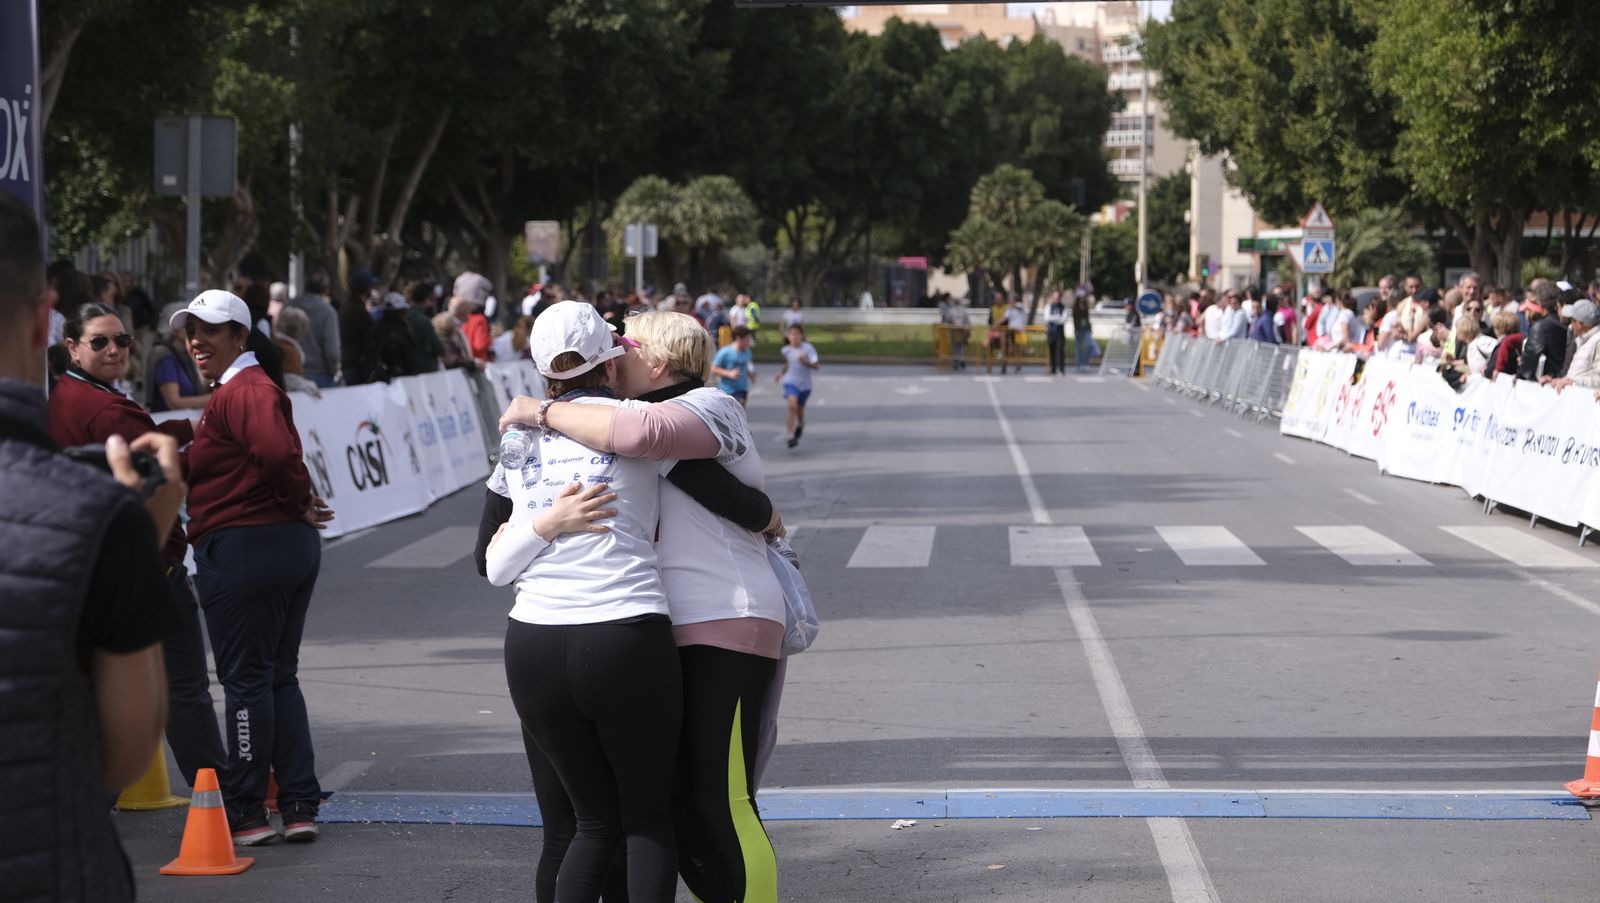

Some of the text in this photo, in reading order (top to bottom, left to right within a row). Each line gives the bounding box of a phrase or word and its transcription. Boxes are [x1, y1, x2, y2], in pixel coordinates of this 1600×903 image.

[347, 438, 389, 492] CASI
[557, 456, 584, 465] cajamar
[590, 455, 614, 465] CASI
